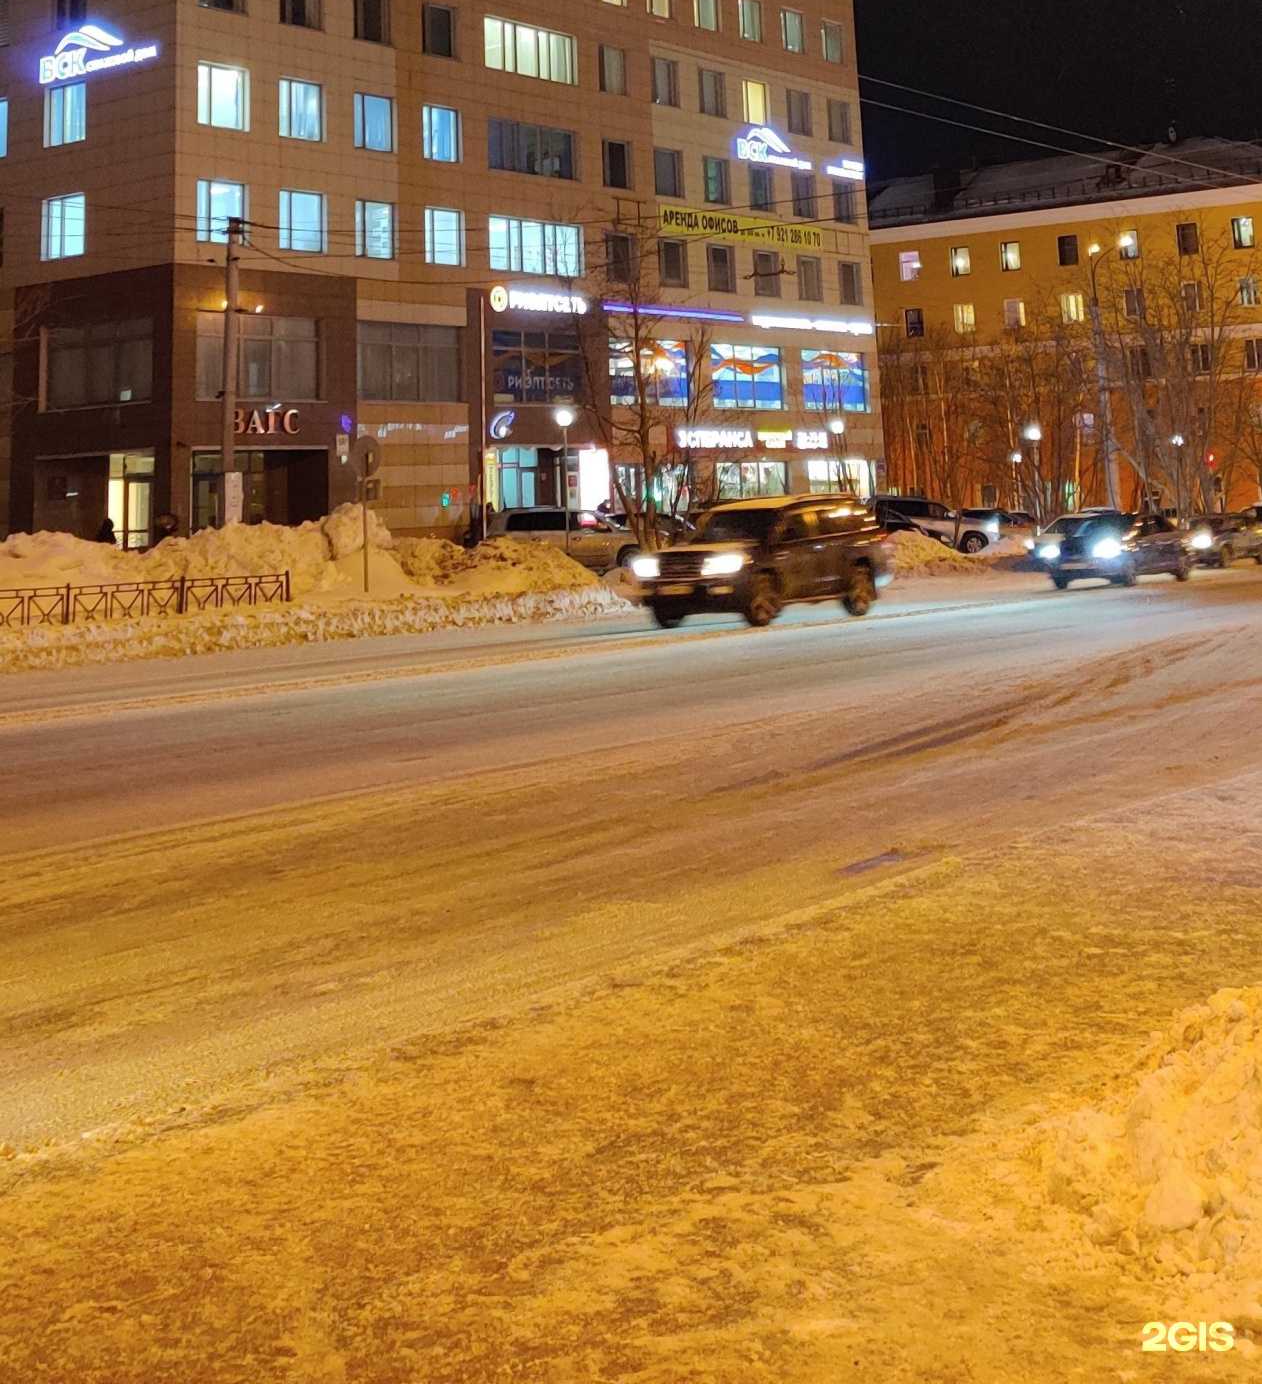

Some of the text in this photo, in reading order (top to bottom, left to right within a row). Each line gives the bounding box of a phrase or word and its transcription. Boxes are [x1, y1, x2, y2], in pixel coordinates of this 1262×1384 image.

[39, 48, 87, 84] ВСК
[663, 210, 699, 231] АРЕНДА
[701, 215, 739, 234] ОФИСОВ
[776, 228, 788, 242] 921
